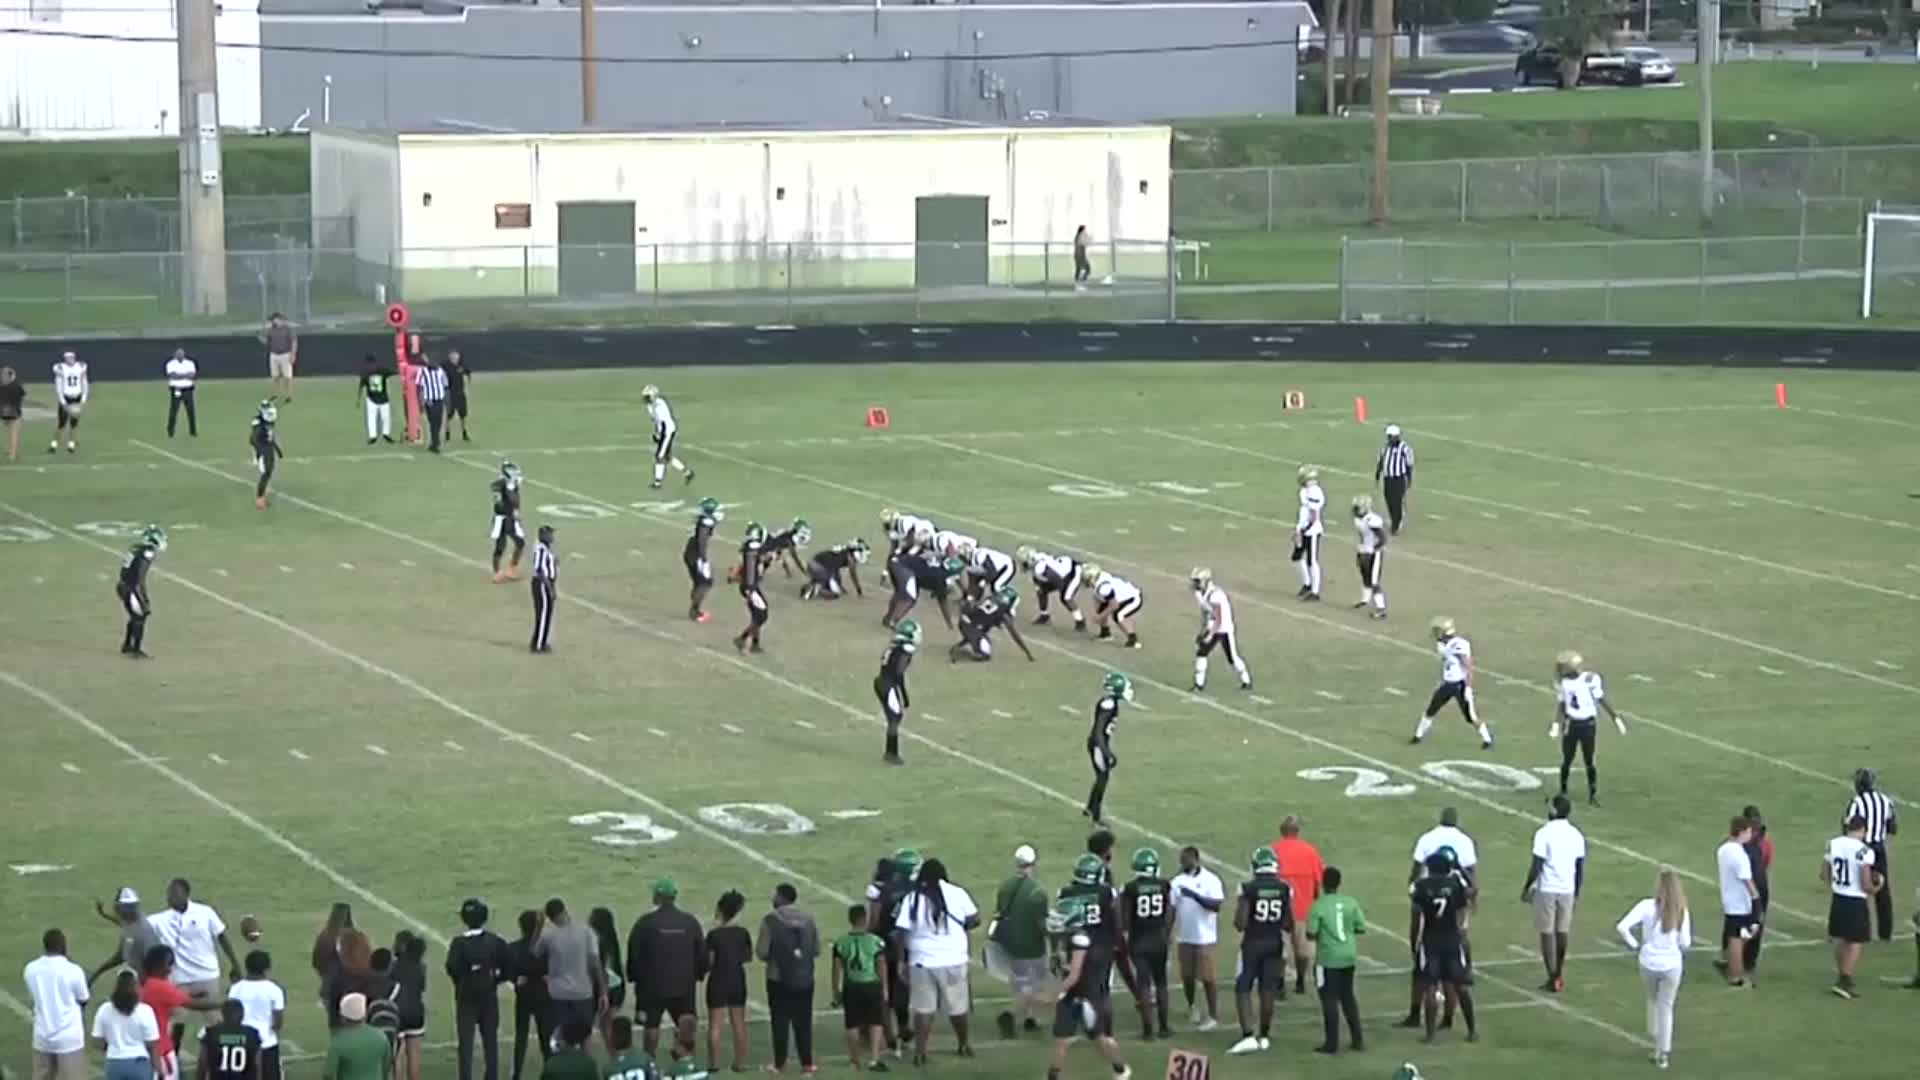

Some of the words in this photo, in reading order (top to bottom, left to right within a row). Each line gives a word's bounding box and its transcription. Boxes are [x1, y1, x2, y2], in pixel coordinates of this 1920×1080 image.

[1295, 760, 1542, 798] 20
[568, 803, 816, 845] 30
[1833, 856, 1850, 887] 31
[1136, 894, 1163, 918] 85
[1253, 899, 1282, 923] 95
[1433, 897, 1447, 917] 7
[219, 1046, 246, 1072] 10
[1169, 1055, 1203, 1080] 30
